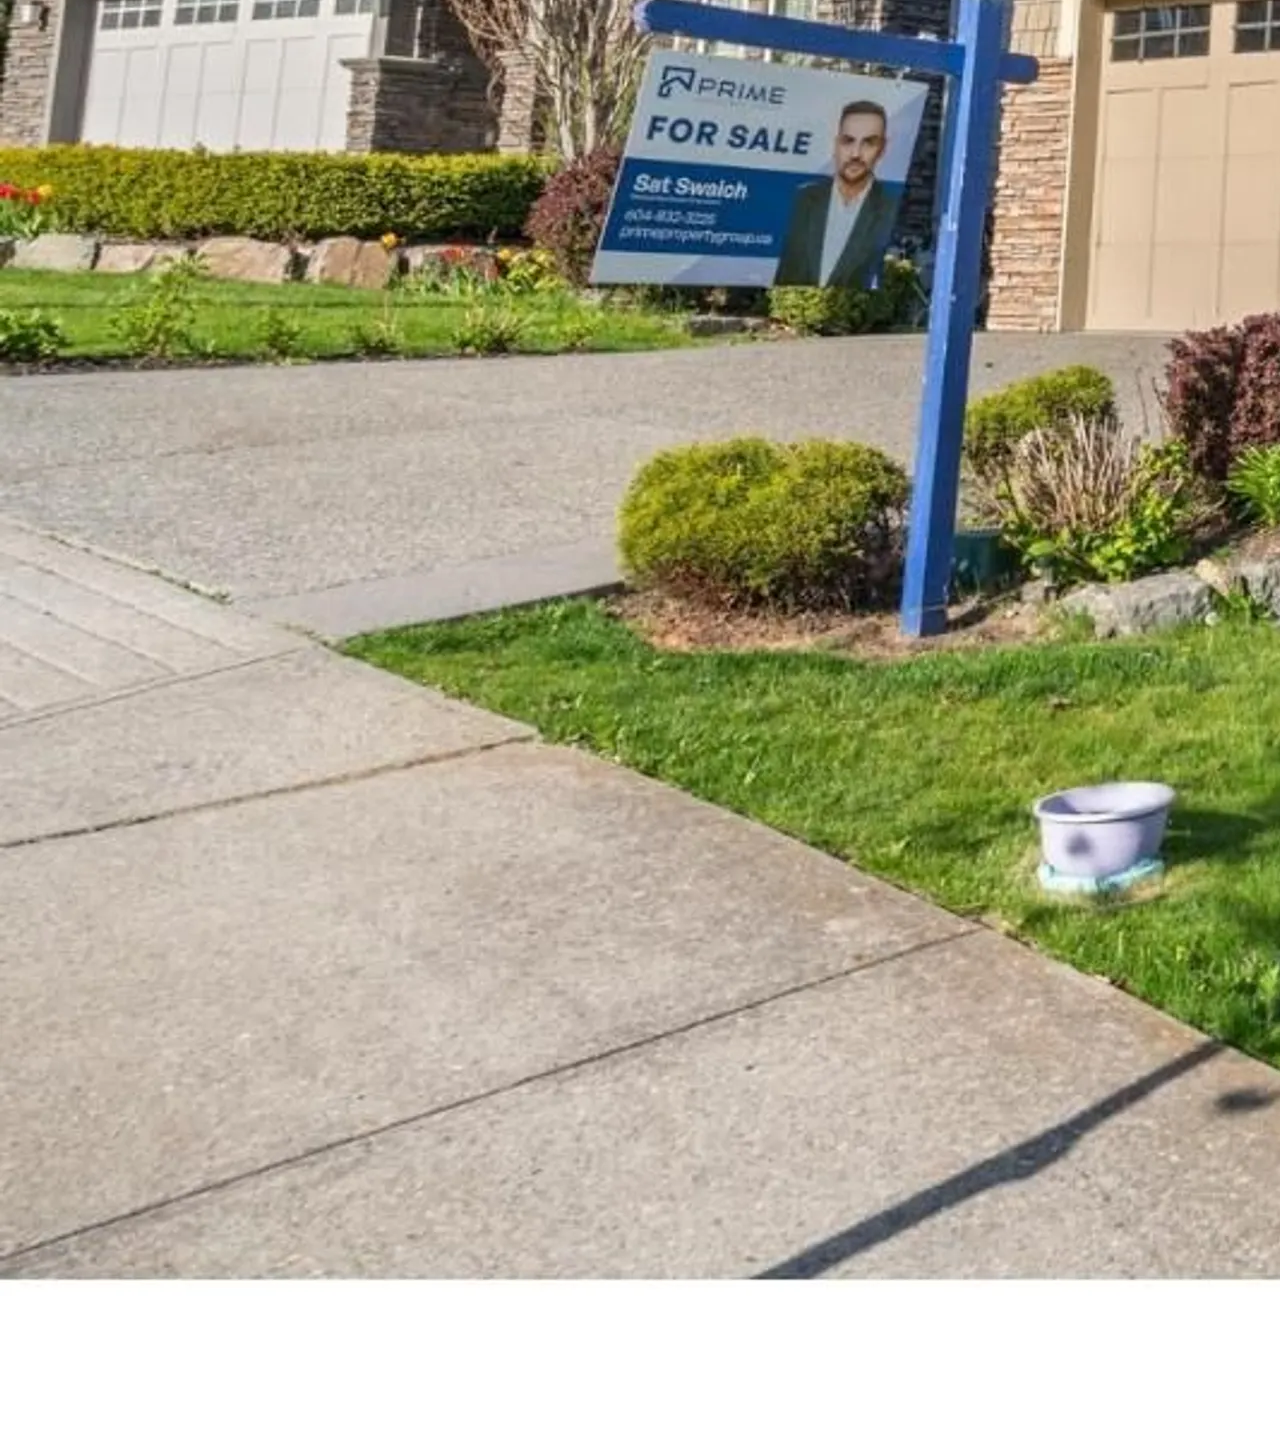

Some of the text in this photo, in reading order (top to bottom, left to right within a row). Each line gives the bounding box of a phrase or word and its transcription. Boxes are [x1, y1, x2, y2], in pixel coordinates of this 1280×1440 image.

[697, 77, 787, 105] PRIME
[646, 115, 813, 155] FOR SALE
[633, 173, 672, 194] Sat
[674, 177, 748, 201] Swaich
